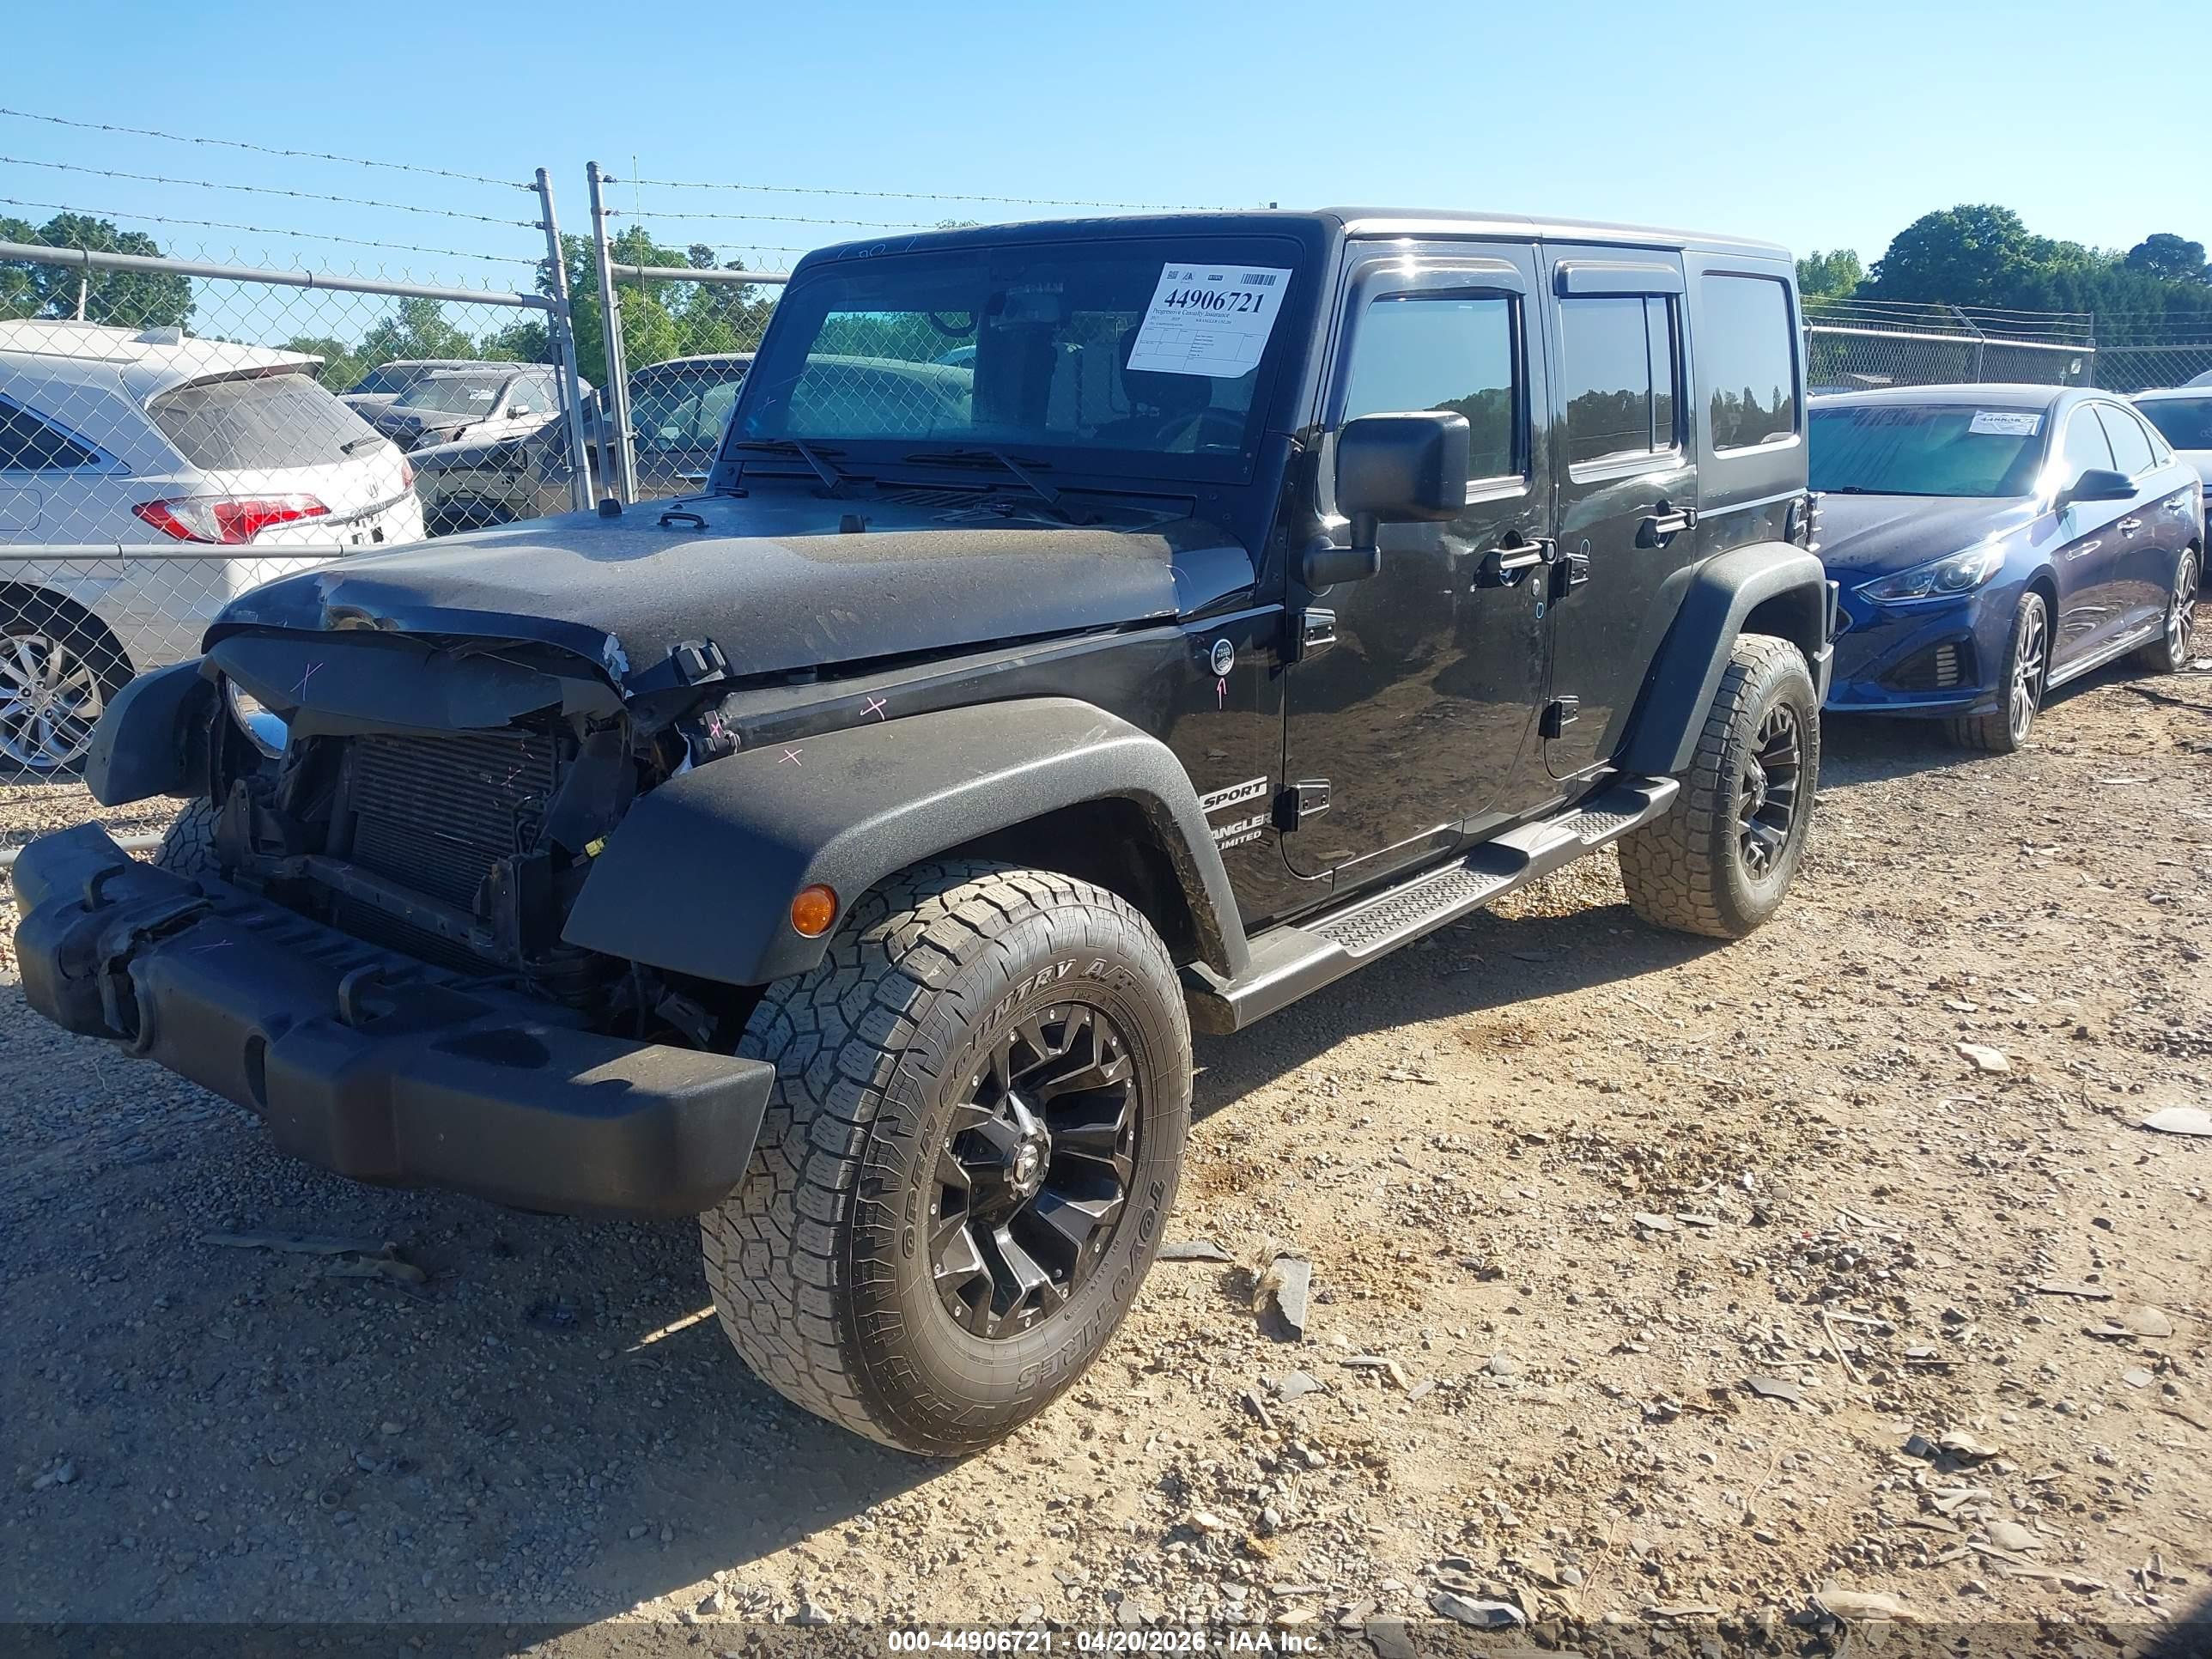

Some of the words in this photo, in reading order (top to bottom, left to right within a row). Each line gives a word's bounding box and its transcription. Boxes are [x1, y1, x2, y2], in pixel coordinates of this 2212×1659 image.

[1164, 289, 1265, 313] 44906721
[1202, 781, 1266, 810] SPORT
[902, 1112, 939, 1259] OPEN
[939, 957, 1078, 1109] COUNTRY
[1113, 1179, 1167, 1302] TOYO
[1016, 1298, 1111, 1395] TIRES
